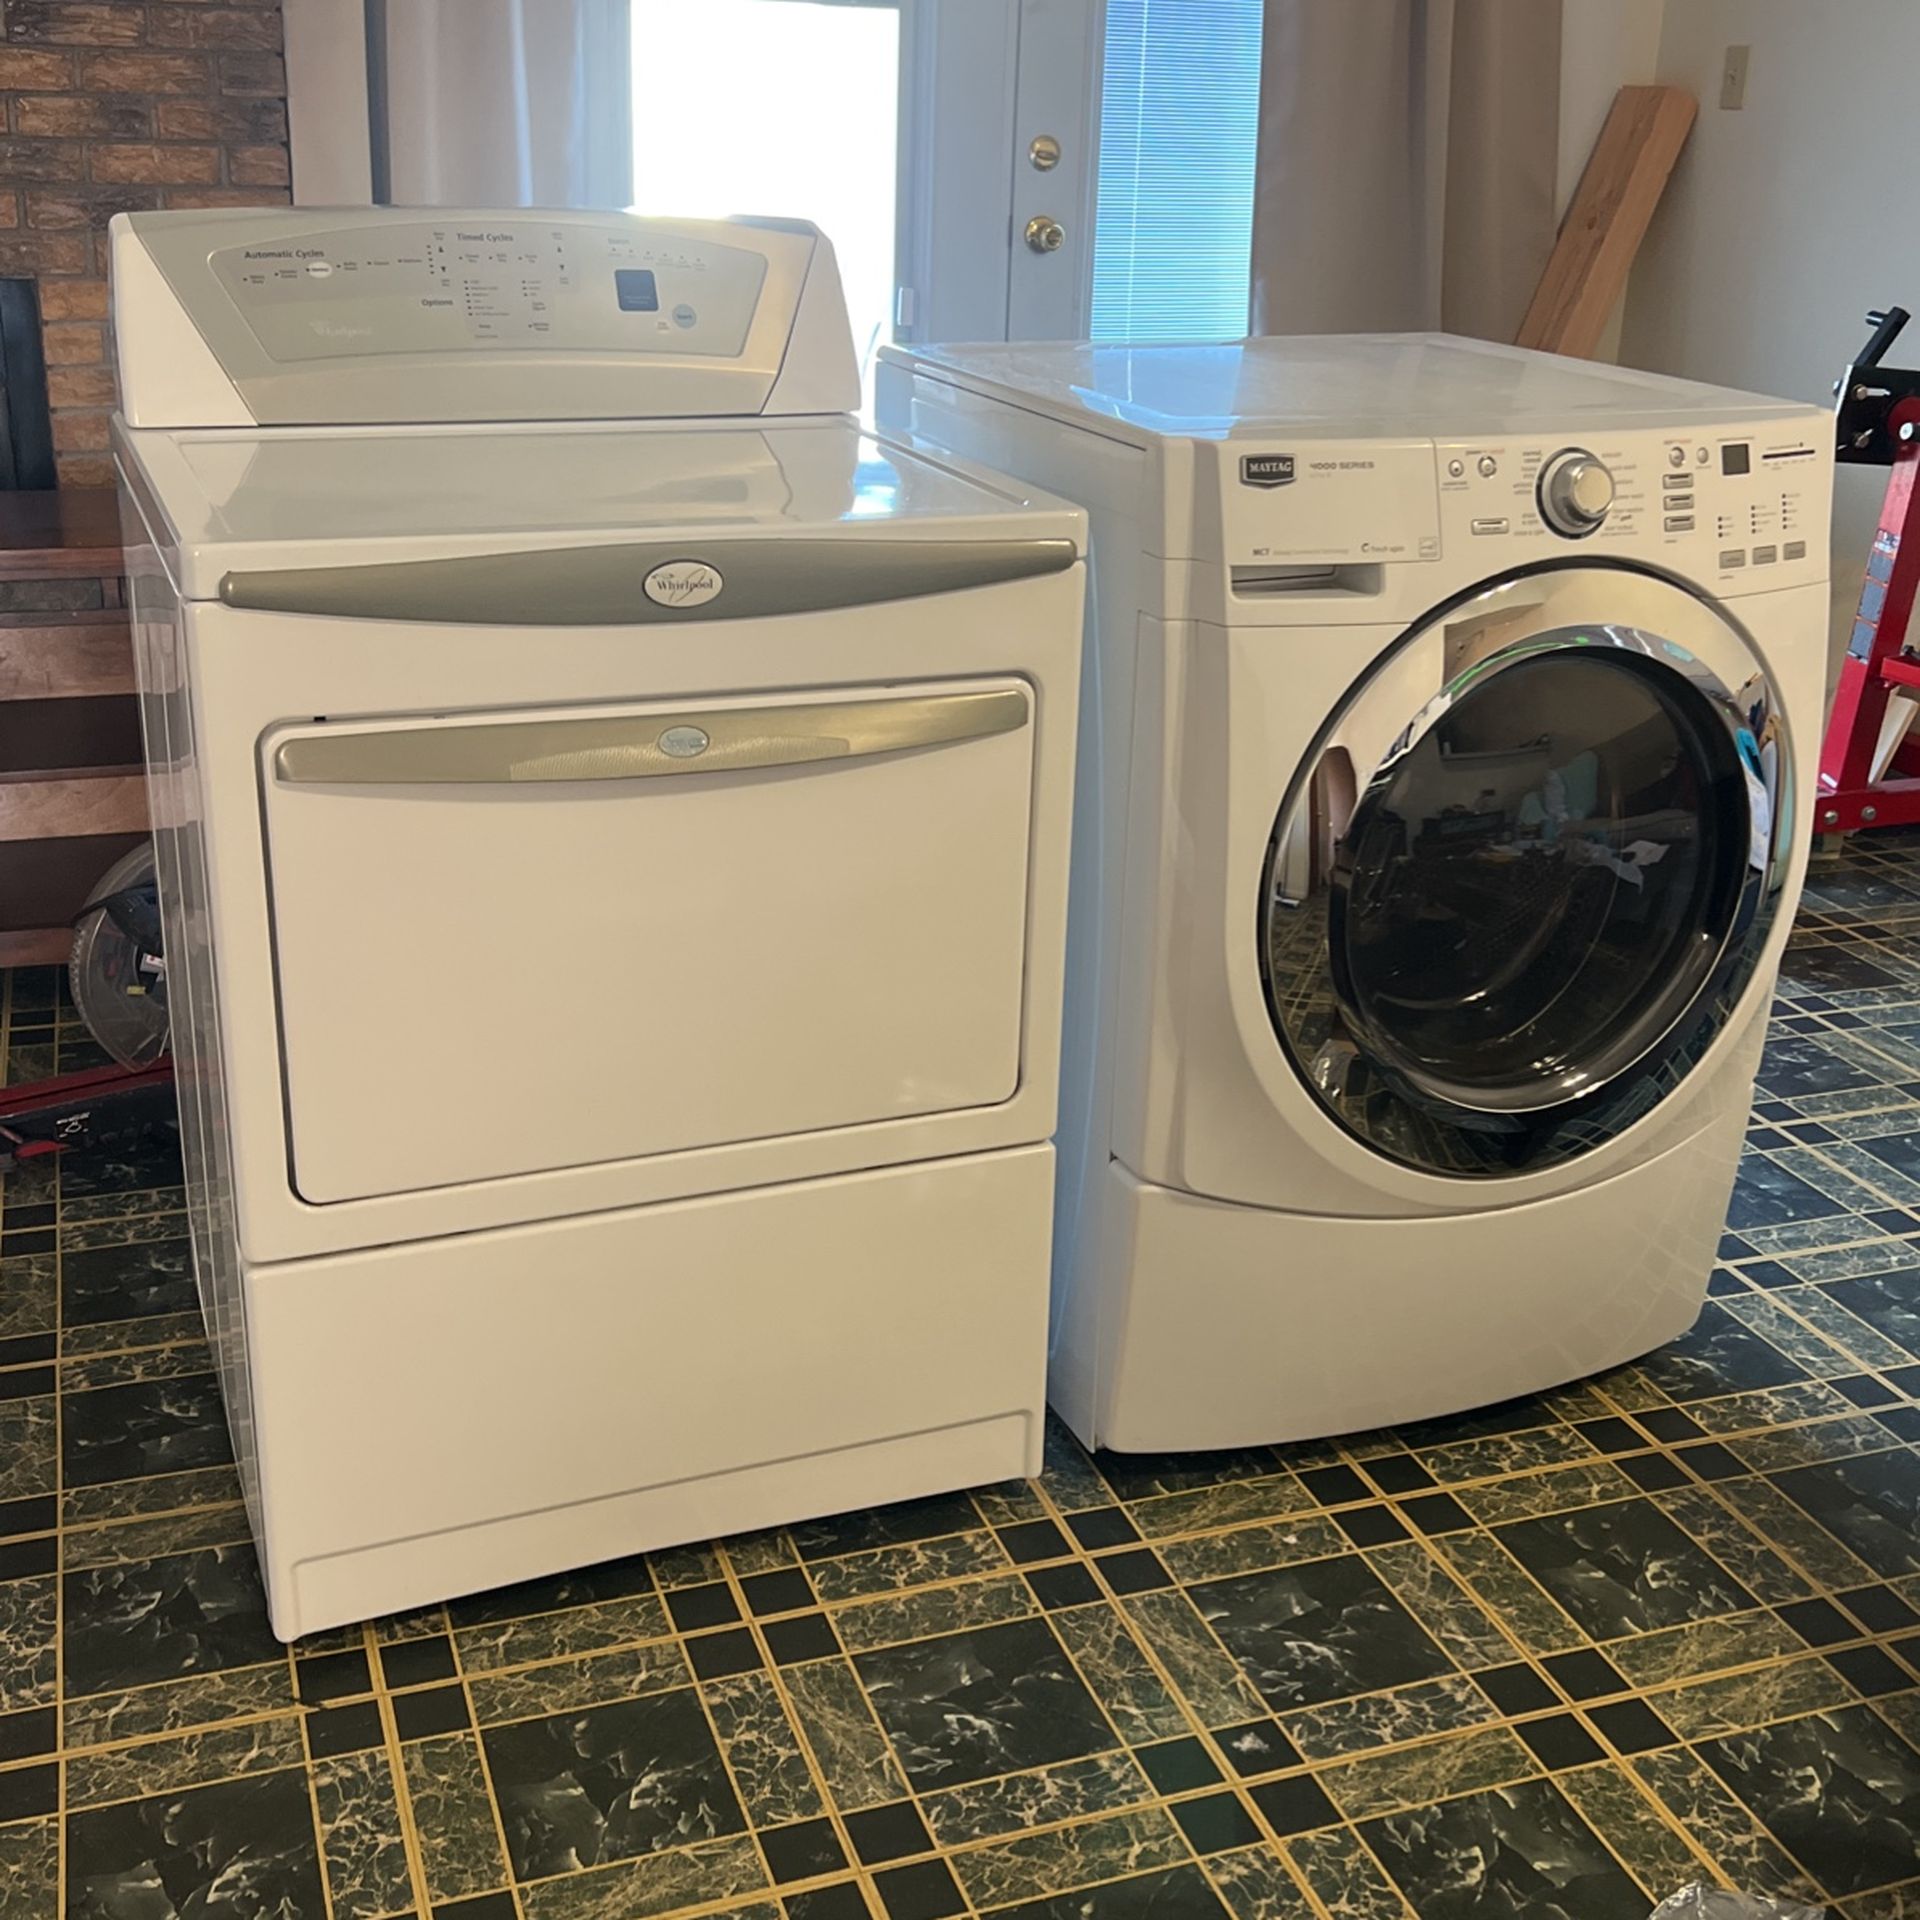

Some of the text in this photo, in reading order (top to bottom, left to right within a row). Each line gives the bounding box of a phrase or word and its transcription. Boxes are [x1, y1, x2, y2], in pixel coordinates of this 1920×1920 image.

[456, 233, 484, 242] Timed
[486, 233, 514, 243] Cycles
[244, 249, 325, 259] Automatic Cycles
[421, 299, 453, 307] Options
[1250, 461, 1292, 473] MAYTAG
[1309, 461, 1375, 471] 4000 SERIES
[656, 578, 714, 592] Whirlpool
